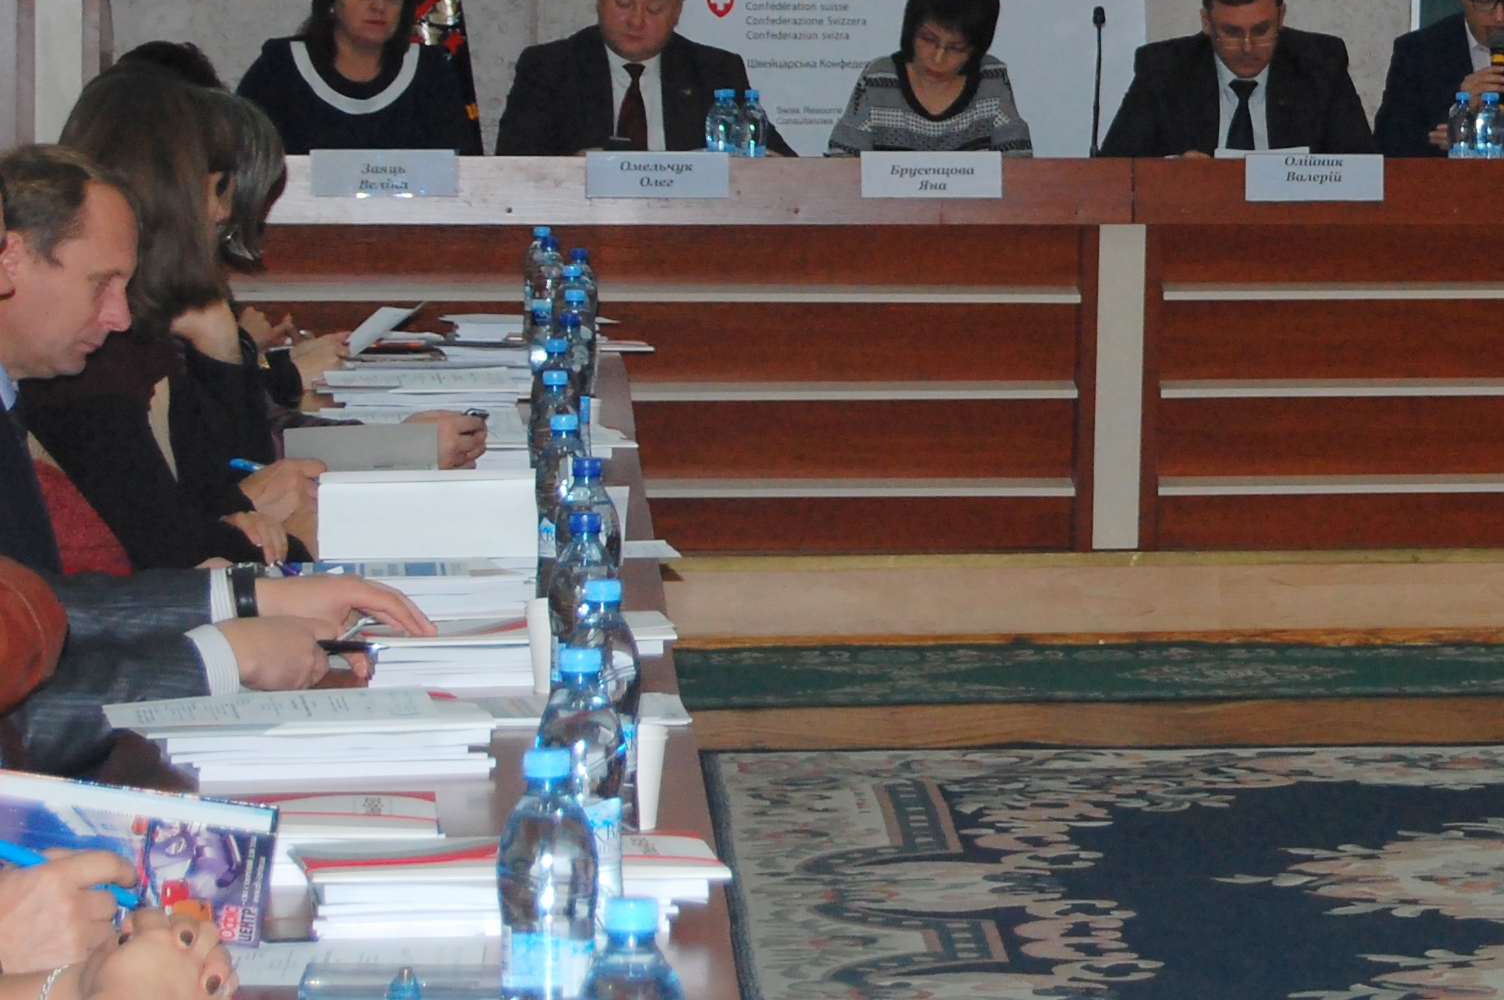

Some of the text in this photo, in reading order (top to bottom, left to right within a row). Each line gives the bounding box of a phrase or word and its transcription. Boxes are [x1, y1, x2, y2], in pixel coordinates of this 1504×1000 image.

[820, 3, 849, 12] suisse
[745, 15, 867, 26] Confederazione Svizzera
[821, 31, 850, 41] svizra
[1284, 155, 1344, 167] Олійник
[360, 163, 406, 176] Заяць
[619, 160, 693, 174] Омельчук
[889, 164, 975, 178] Брусенцова
[639, 176, 674, 187] Олег
[1286, 171, 1342, 185] Валерій
[918, 180, 947, 191] Яна
